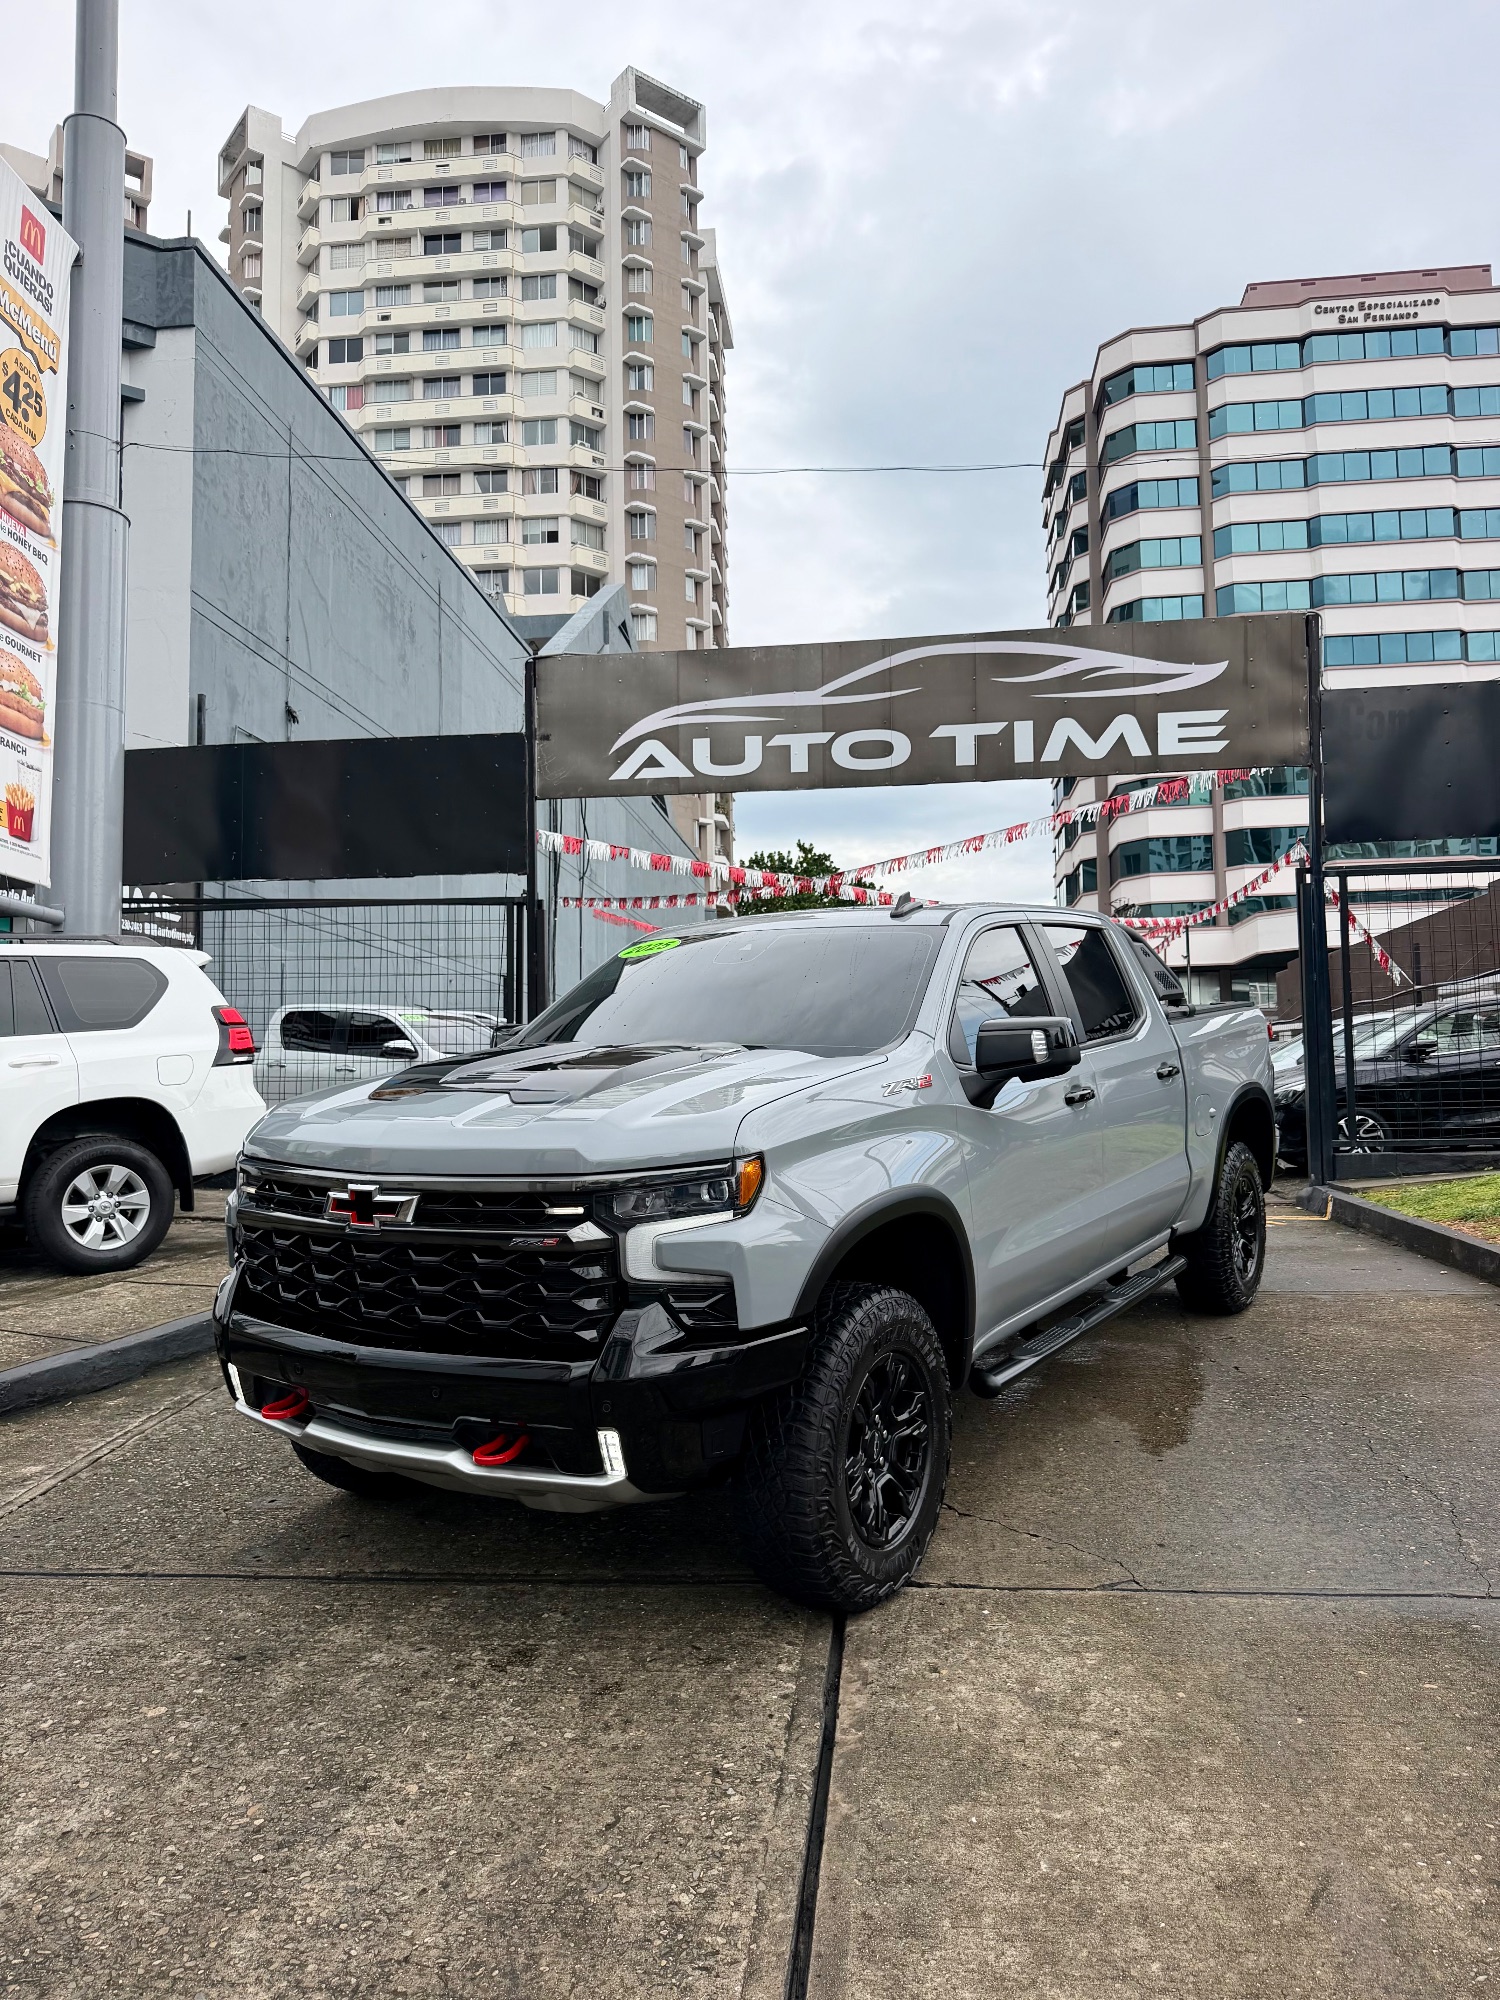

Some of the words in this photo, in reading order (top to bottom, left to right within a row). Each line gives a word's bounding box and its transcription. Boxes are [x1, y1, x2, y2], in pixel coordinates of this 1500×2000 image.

[4, 254, 53, 312] QUIERAS!
[5, 239, 54, 299] ¡CUANDO
[7, 527, 32, 552] HONEY
[32, 546, 48, 566] BBQ
[5, 635, 42, 663] GOURMET
[0, 736, 27, 756] RANCH
[609, 729, 911, 781] AUTO
[929, 709, 1230, 766] TIME
[881, 1074, 933, 1097] ZR2
